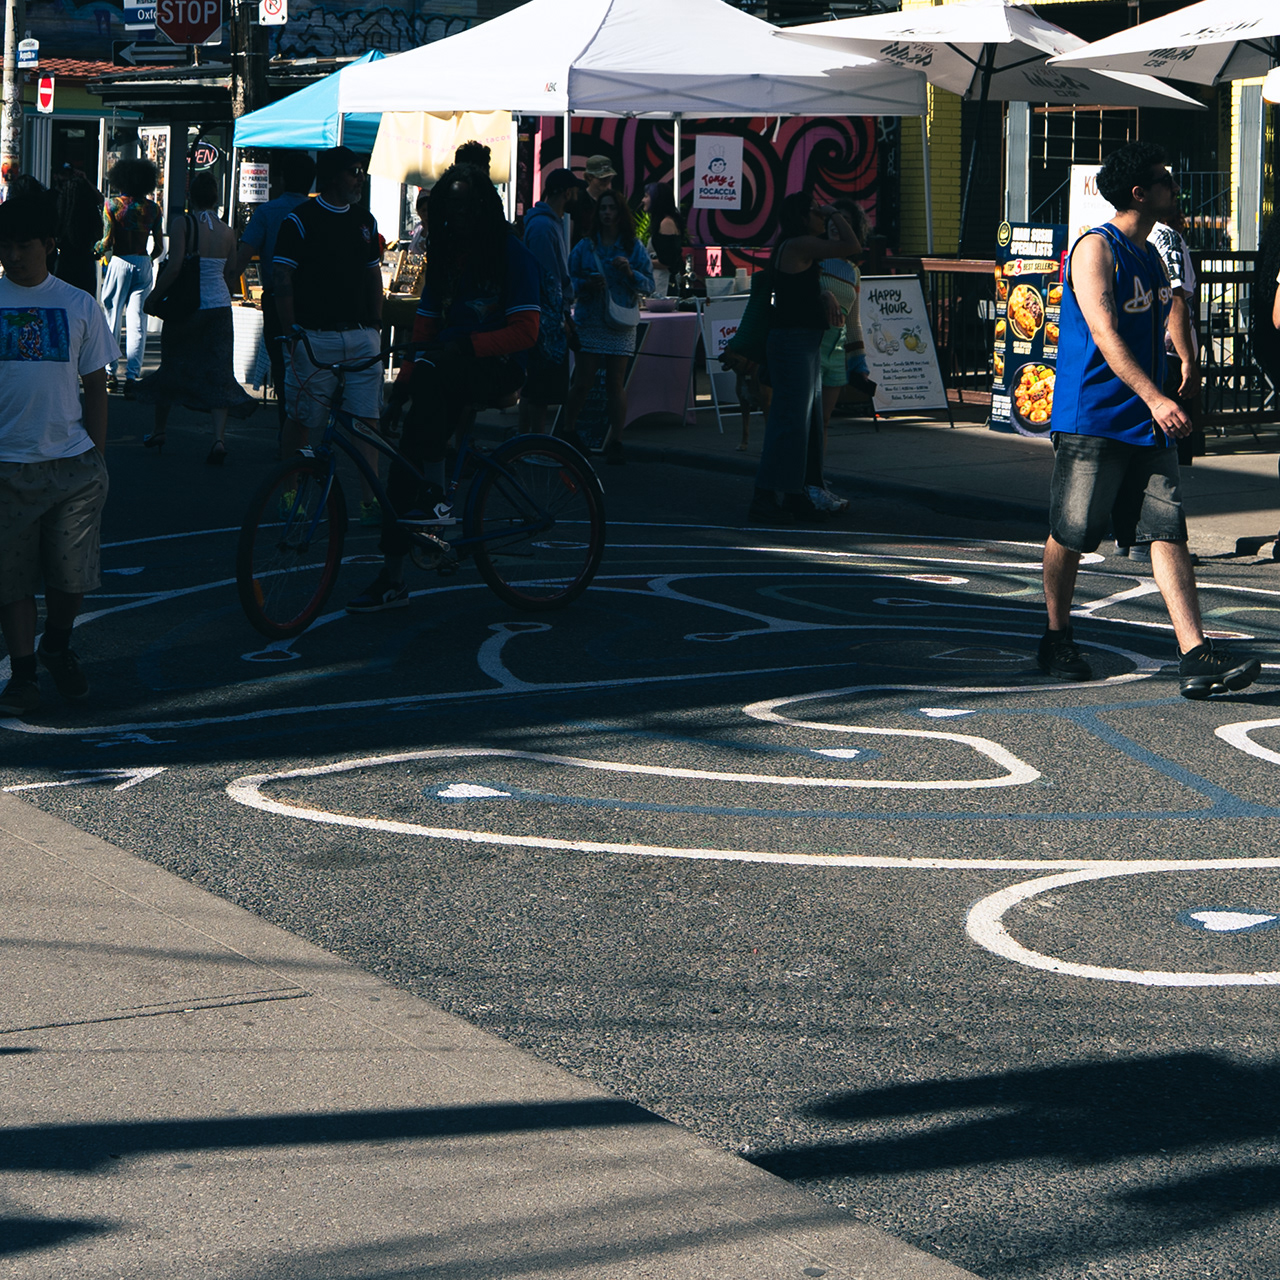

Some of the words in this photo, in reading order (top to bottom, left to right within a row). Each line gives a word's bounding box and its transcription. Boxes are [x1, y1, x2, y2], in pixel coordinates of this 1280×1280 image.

[137, 9, 157, 20] Oxfo
[160, 0, 218, 25] STOP
[702, 173, 736, 188] Tony's
[699, 187, 737, 196] FOCACCIA
[1010, 241, 1053, 257] SPECIALISTS
[1015, 259, 1023, 275] 3
[1023, 262, 1034, 271] BEST
[1034, 262, 1054, 271] SELLERS
[867, 288, 902, 305] HAPPY
[879, 301, 913, 316] HOUR
